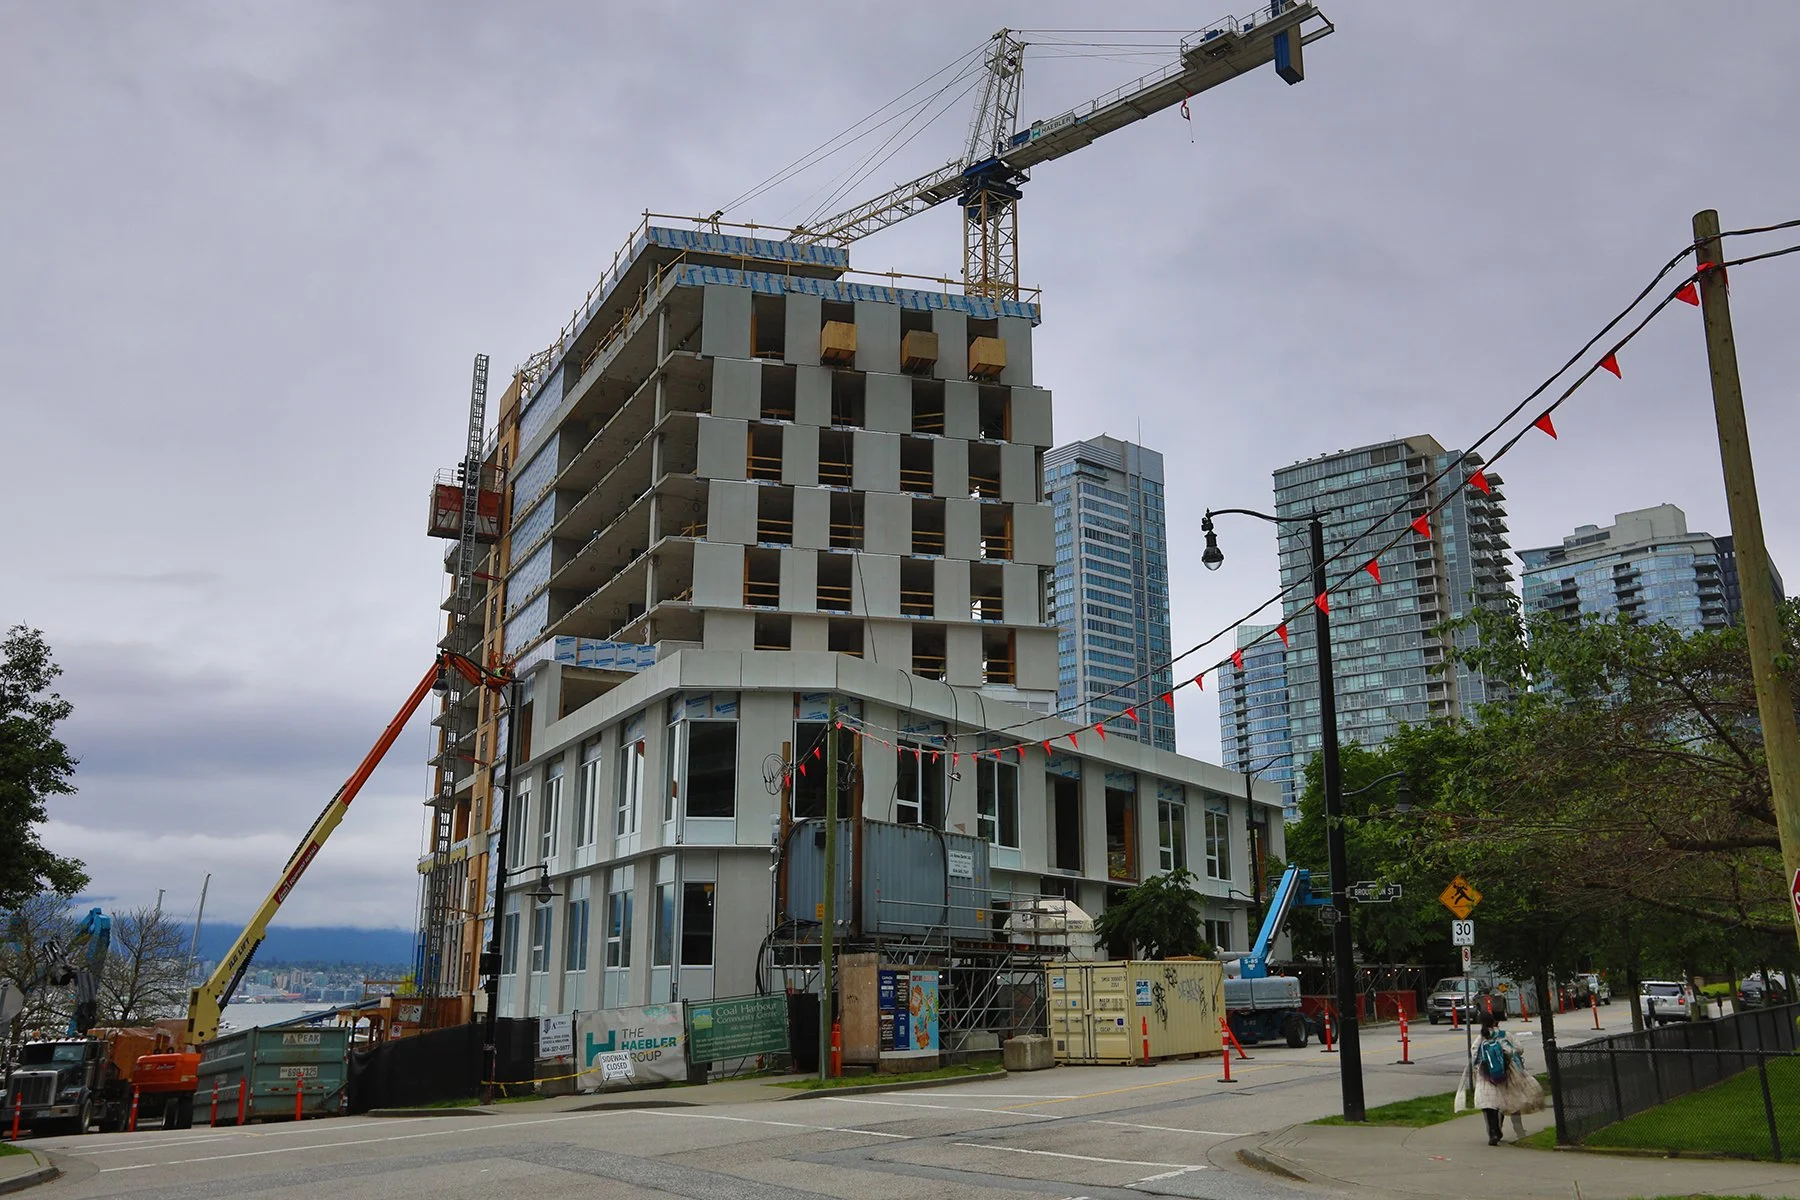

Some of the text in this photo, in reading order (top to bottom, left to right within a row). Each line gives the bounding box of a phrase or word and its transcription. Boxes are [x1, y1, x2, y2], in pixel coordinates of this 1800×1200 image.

[1041, 116, 1071, 134] HAEBLER
[1354, 887, 1395, 896] BROUON ST
[1455, 923, 1471, 936] 30
[228, 936, 250, 971] JLG LIFT
[716, 1002, 777, 1017] Coal Harbour
[717, 1013, 755, 1024] Community
[297, 1033, 320, 1042] PEAK
[622, 1027, 645, 1039] THE
[621, 1037, 677, 1050] HAEBLER
[601, 1054, 629, 1063] SIDEWALK
[631, 1050, 662, 1063] ROUP
[606, 1062, 627, 1071] CLOSED
